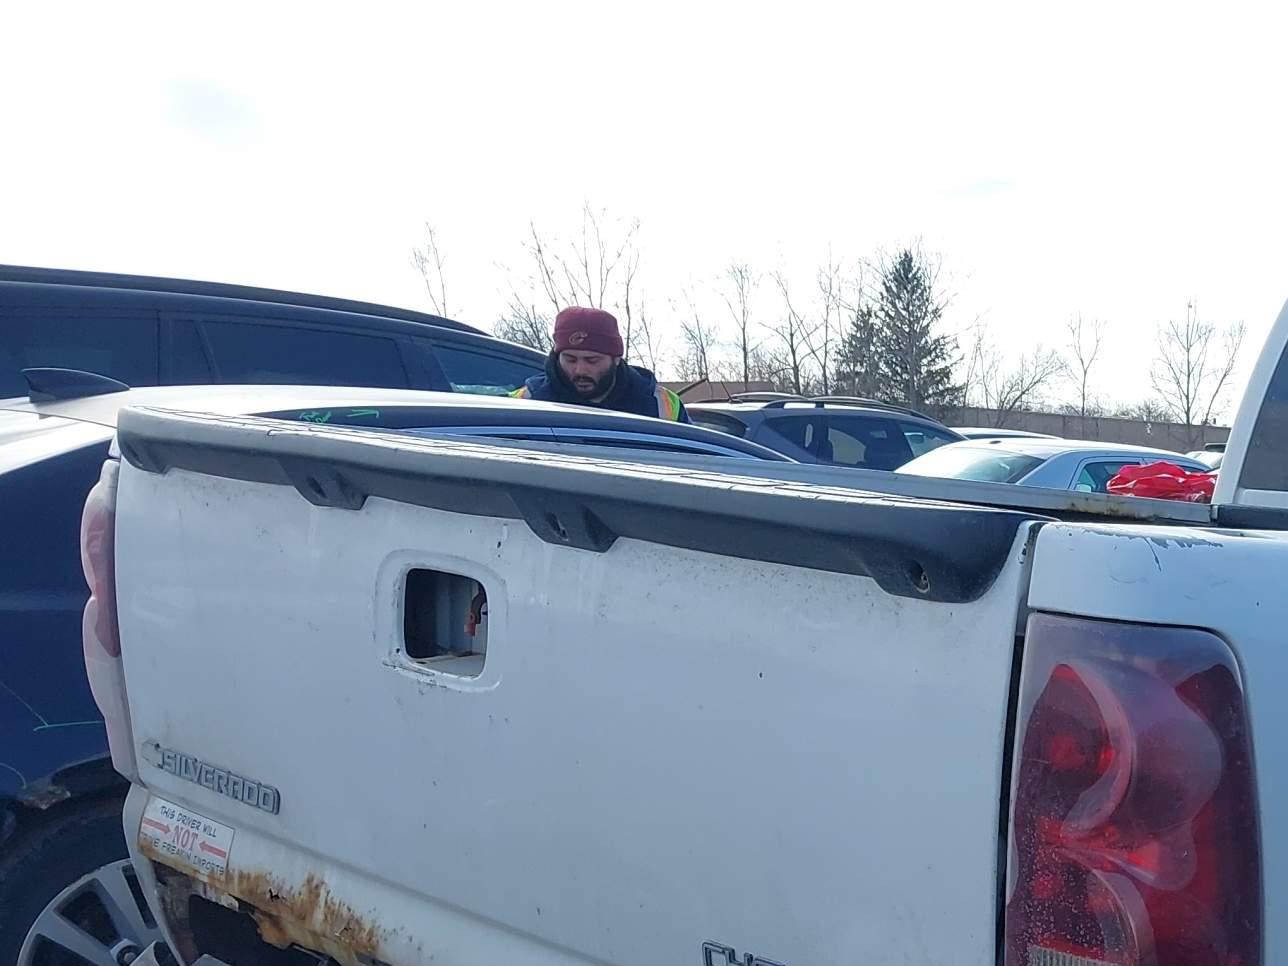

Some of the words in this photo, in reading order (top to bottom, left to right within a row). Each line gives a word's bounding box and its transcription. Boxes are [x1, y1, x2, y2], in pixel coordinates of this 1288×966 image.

[161, 750, 281, 815] SILVERADO
[160, 806, 175, 819] THIS
[177, 813, 202, 830] DRIVER
[203, 823, 217, 838] WILL
[172, 825, 199, 851] NOT
